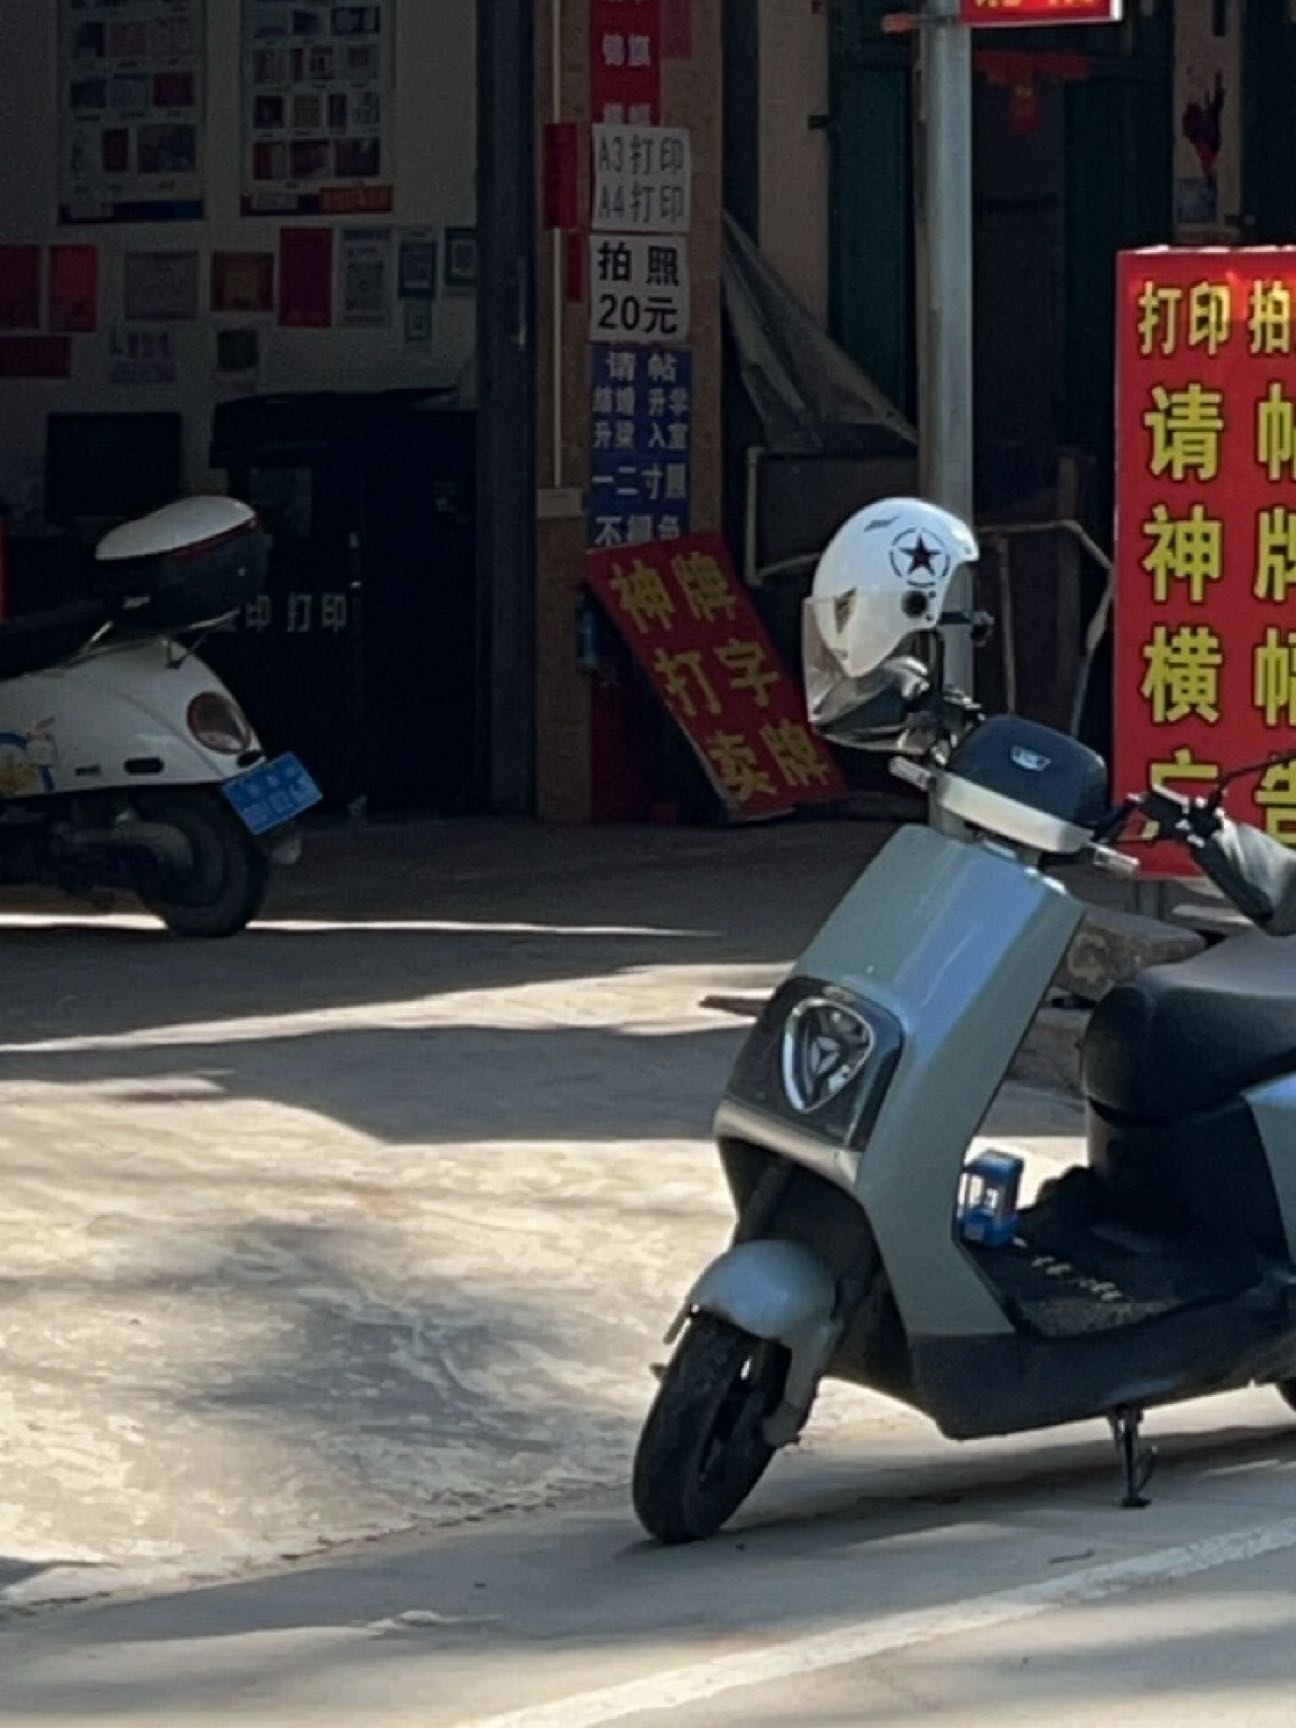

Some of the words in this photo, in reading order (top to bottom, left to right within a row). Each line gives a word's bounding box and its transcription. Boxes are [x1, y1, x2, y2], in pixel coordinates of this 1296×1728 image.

[599, 133, 685, 175] A3打印
[599, 181, 685, 225] A4打印
[597, 239, 680, 287] 拍照
[597, 293, 679, 335] 20元
[1137, 279, 1232, 356] 打印
[287, 592, 348, 635] 打印
[609, 550, 737, 635] 神牌
[653, 636, 778, 718] 打字
